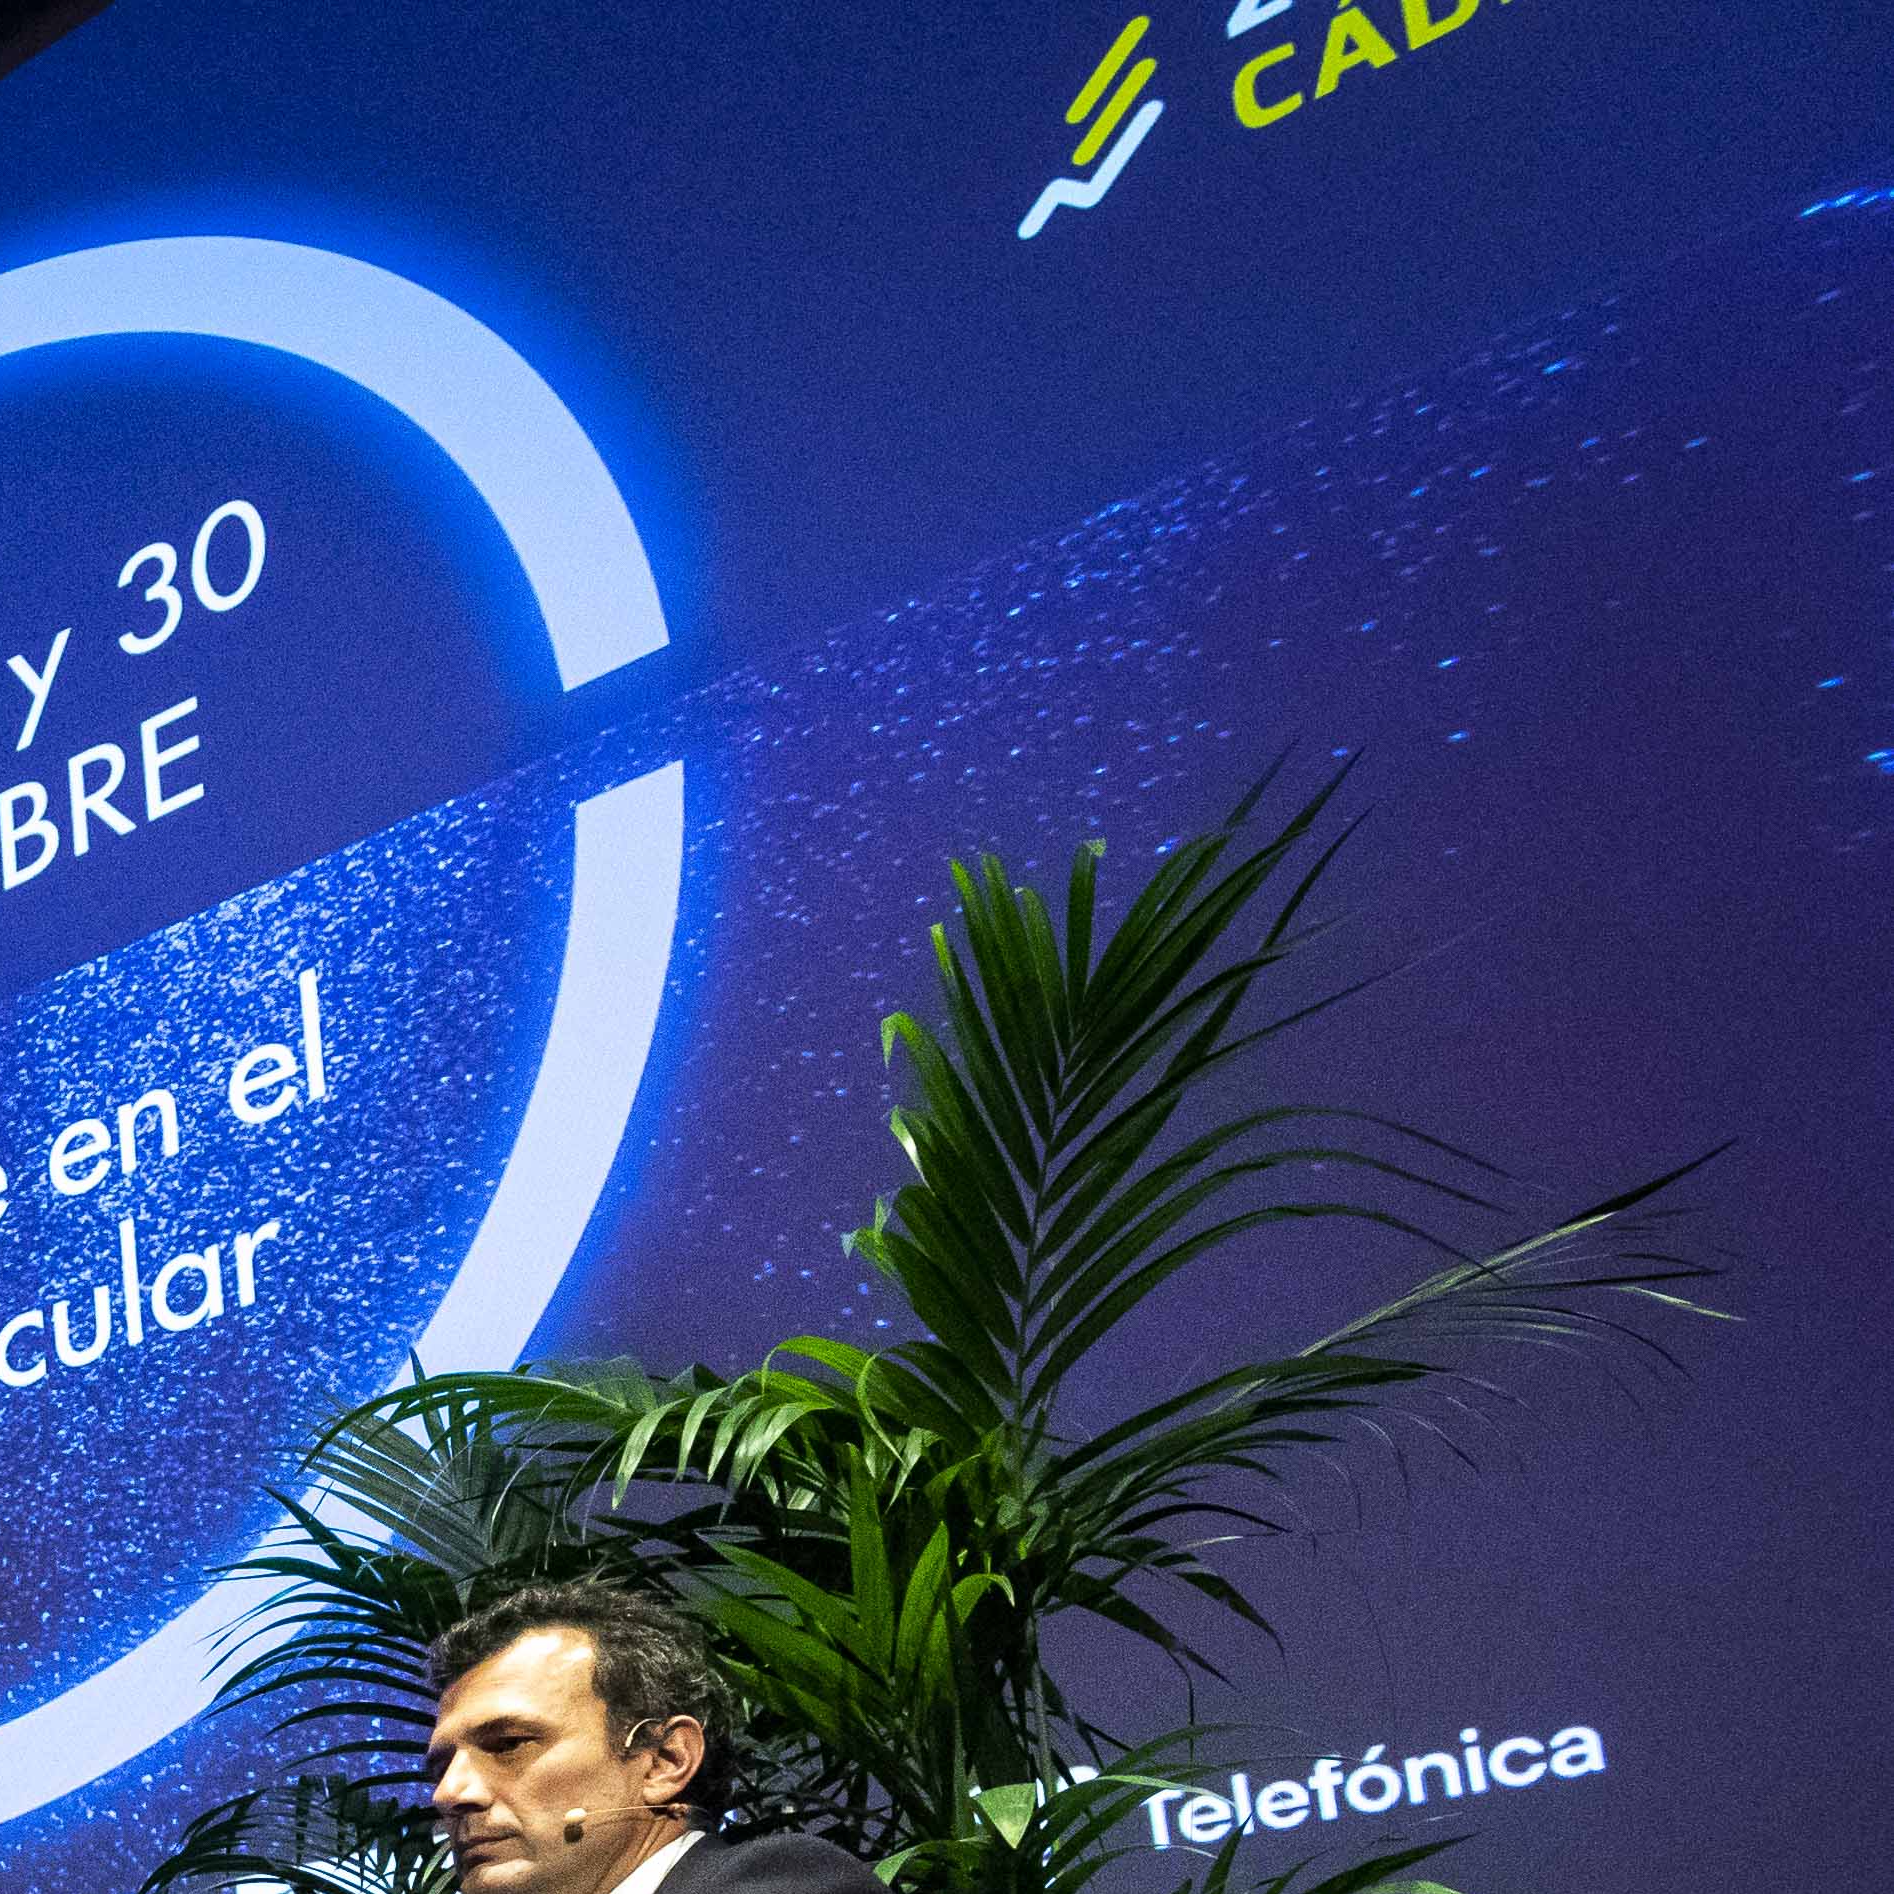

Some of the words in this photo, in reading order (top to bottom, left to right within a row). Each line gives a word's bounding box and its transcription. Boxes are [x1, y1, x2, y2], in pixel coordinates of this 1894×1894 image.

[7, 627, 72, 752] y
[116, 499, 266, 655] 30
[48, 1089, 180, 1195] en
[227, 968, 325, 1124] el
[1140, 1725, 1608, 1851] Telefónica
